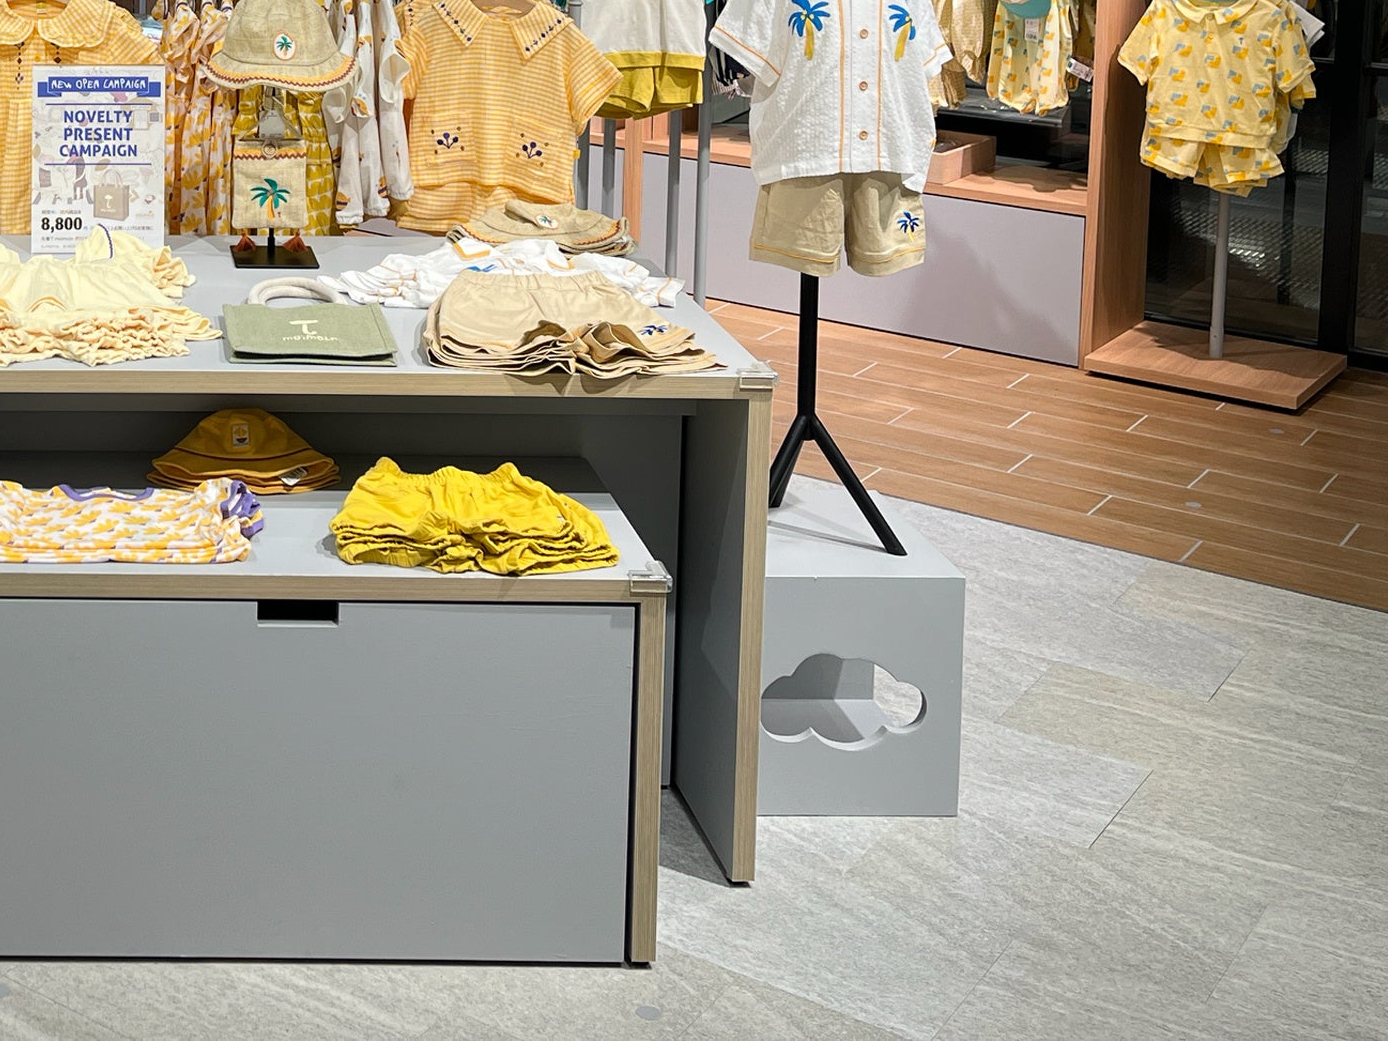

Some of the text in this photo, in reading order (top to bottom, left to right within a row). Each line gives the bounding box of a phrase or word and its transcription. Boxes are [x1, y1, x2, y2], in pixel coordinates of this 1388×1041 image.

[52, 78, 146, 89] NEW OPEN CAMPAIGN
[64, 110, 133, 123] NOVELTY
[64, 128, 133, 141] PRESENT
[59, 144, 138, 157] CAMPAIGN
[41, 217, 82, 233] 8,800
